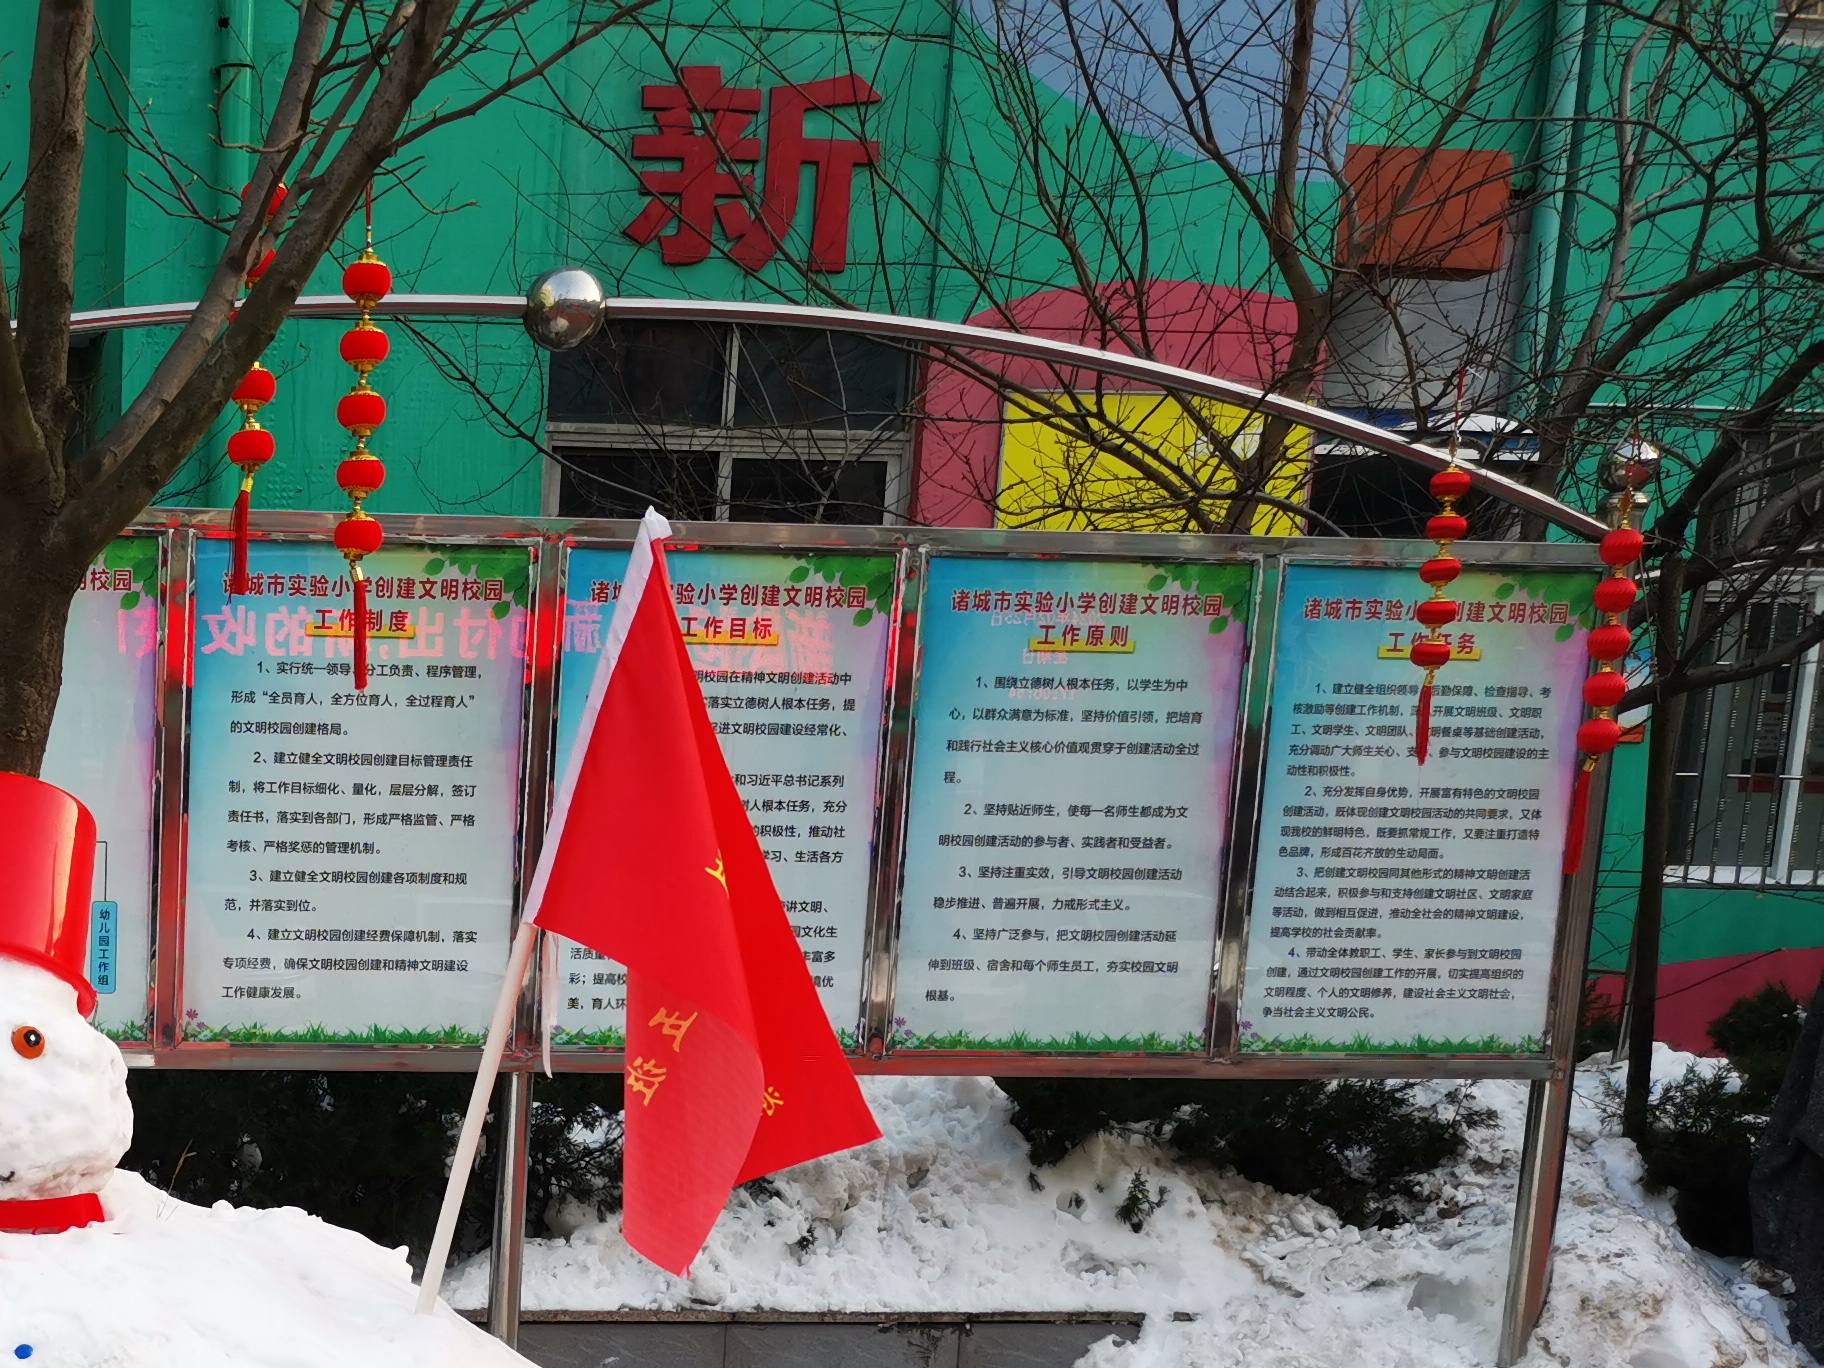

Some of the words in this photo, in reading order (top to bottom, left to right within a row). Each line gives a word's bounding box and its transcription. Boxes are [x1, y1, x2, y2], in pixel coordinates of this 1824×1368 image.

[622, 66, 882, 273] 新
[951, 589, 1224, 617] 诸城市实验小学创建文明校园
[681, 616, 774, 639] 工作目标
[1037, 624, 1130, 648] 工作原则
[98, 908, 111, 986] 幼儿园工作组
